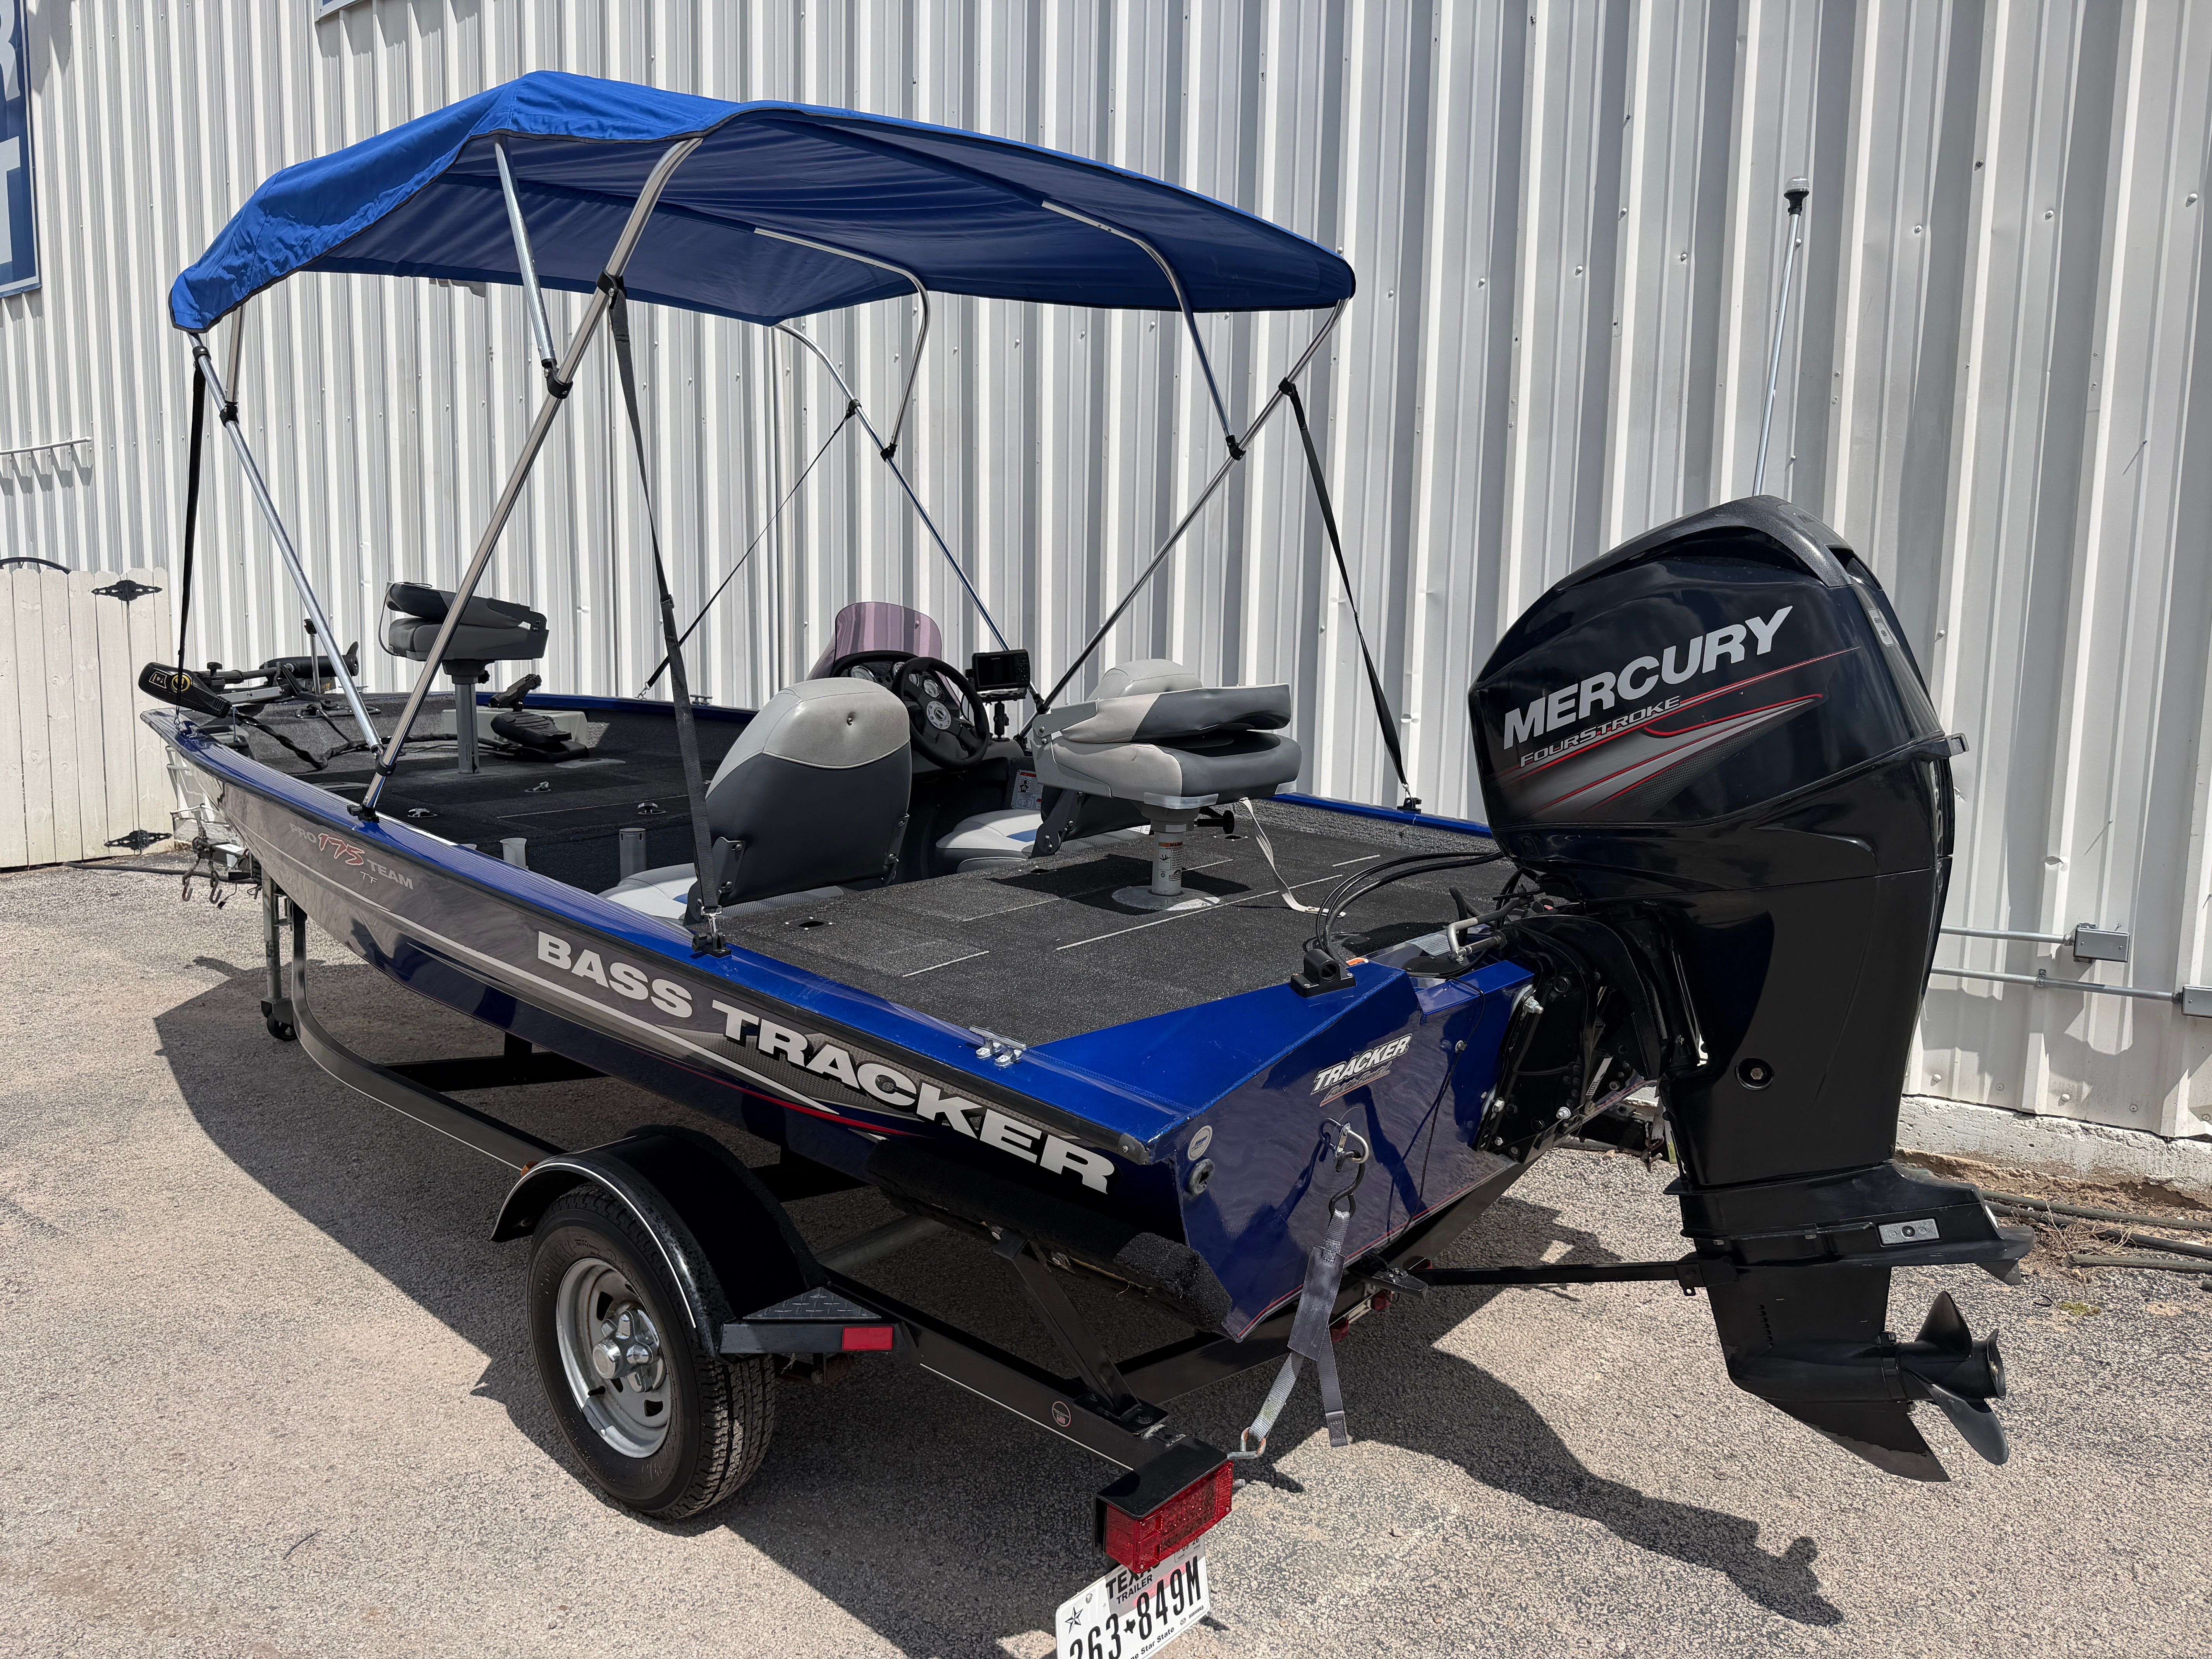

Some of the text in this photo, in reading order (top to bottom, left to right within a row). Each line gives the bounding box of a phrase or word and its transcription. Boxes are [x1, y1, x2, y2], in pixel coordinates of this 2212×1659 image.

[1503, 606, 1793, 750] MERCURY
[1520, 695, 1680, 768] FOURSTROKE
[290, 823, 413, 890] PRO 175 TEAM
[538, 931, 1115, 1194] BASS TRACKER
[1312, 1035, 1412, 1092] TRACKER
[1106, 1562, 1160, 1599] TEX
[1116, 1574, 1152, 1604] TRAILER
[1141, 1640, 1155, 1655] Star
[1157, 1627, 1174, 1643] State
